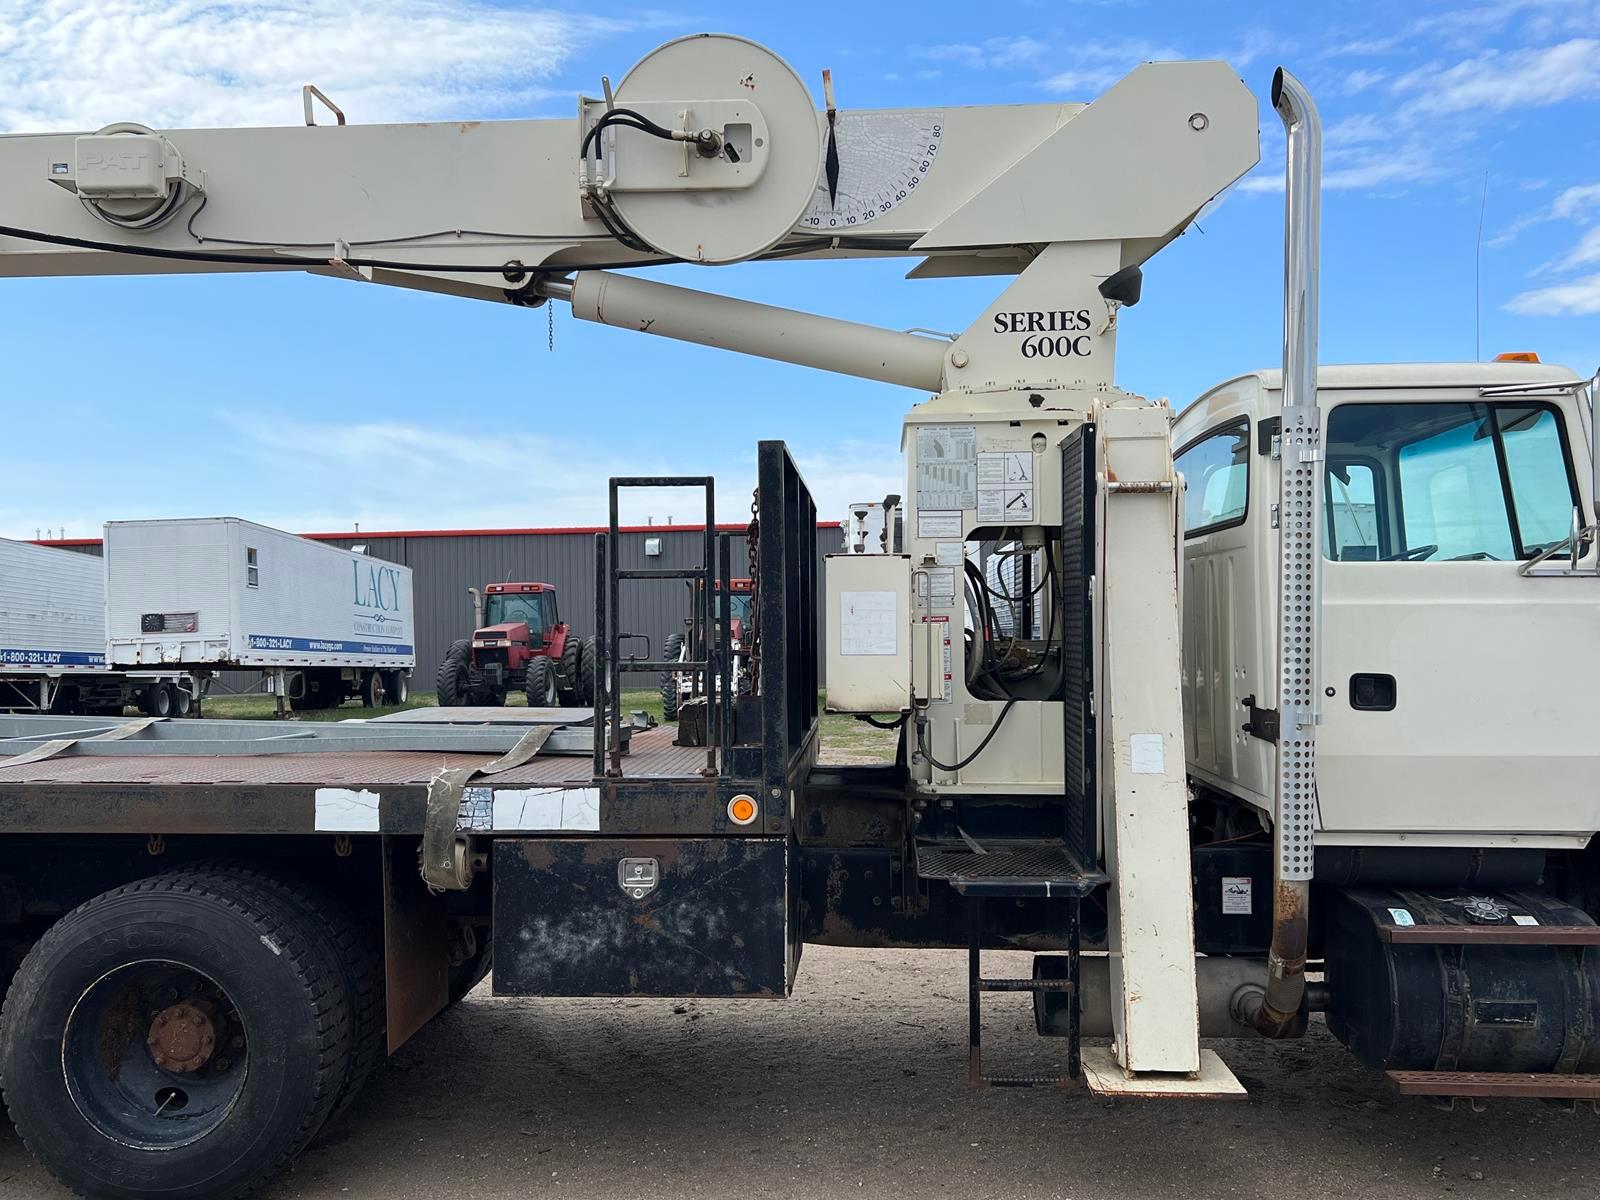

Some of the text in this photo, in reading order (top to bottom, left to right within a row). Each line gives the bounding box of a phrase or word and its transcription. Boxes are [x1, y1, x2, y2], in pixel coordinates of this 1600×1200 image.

[932, 124, 942, 138] 80
[926, 144, 937, 157] 70
[79, 152, 149, 171] PAT
[918, 160, 931, 173] 60
[907, 176, 920, 190] 50
[895, 190, 907, 202] 40
[879, 201, 892, 213] 30
[804, 217, 820, 226] -10
[846, 215, 857, 225] 10
[862, 209, 876, 221] 20
[829, 218, 836, 226] 0
[993, 309, 1091, 334] SERIES
[1021, 334, 1092, 359] 600C
[352, 559, 400, 611] LACY
